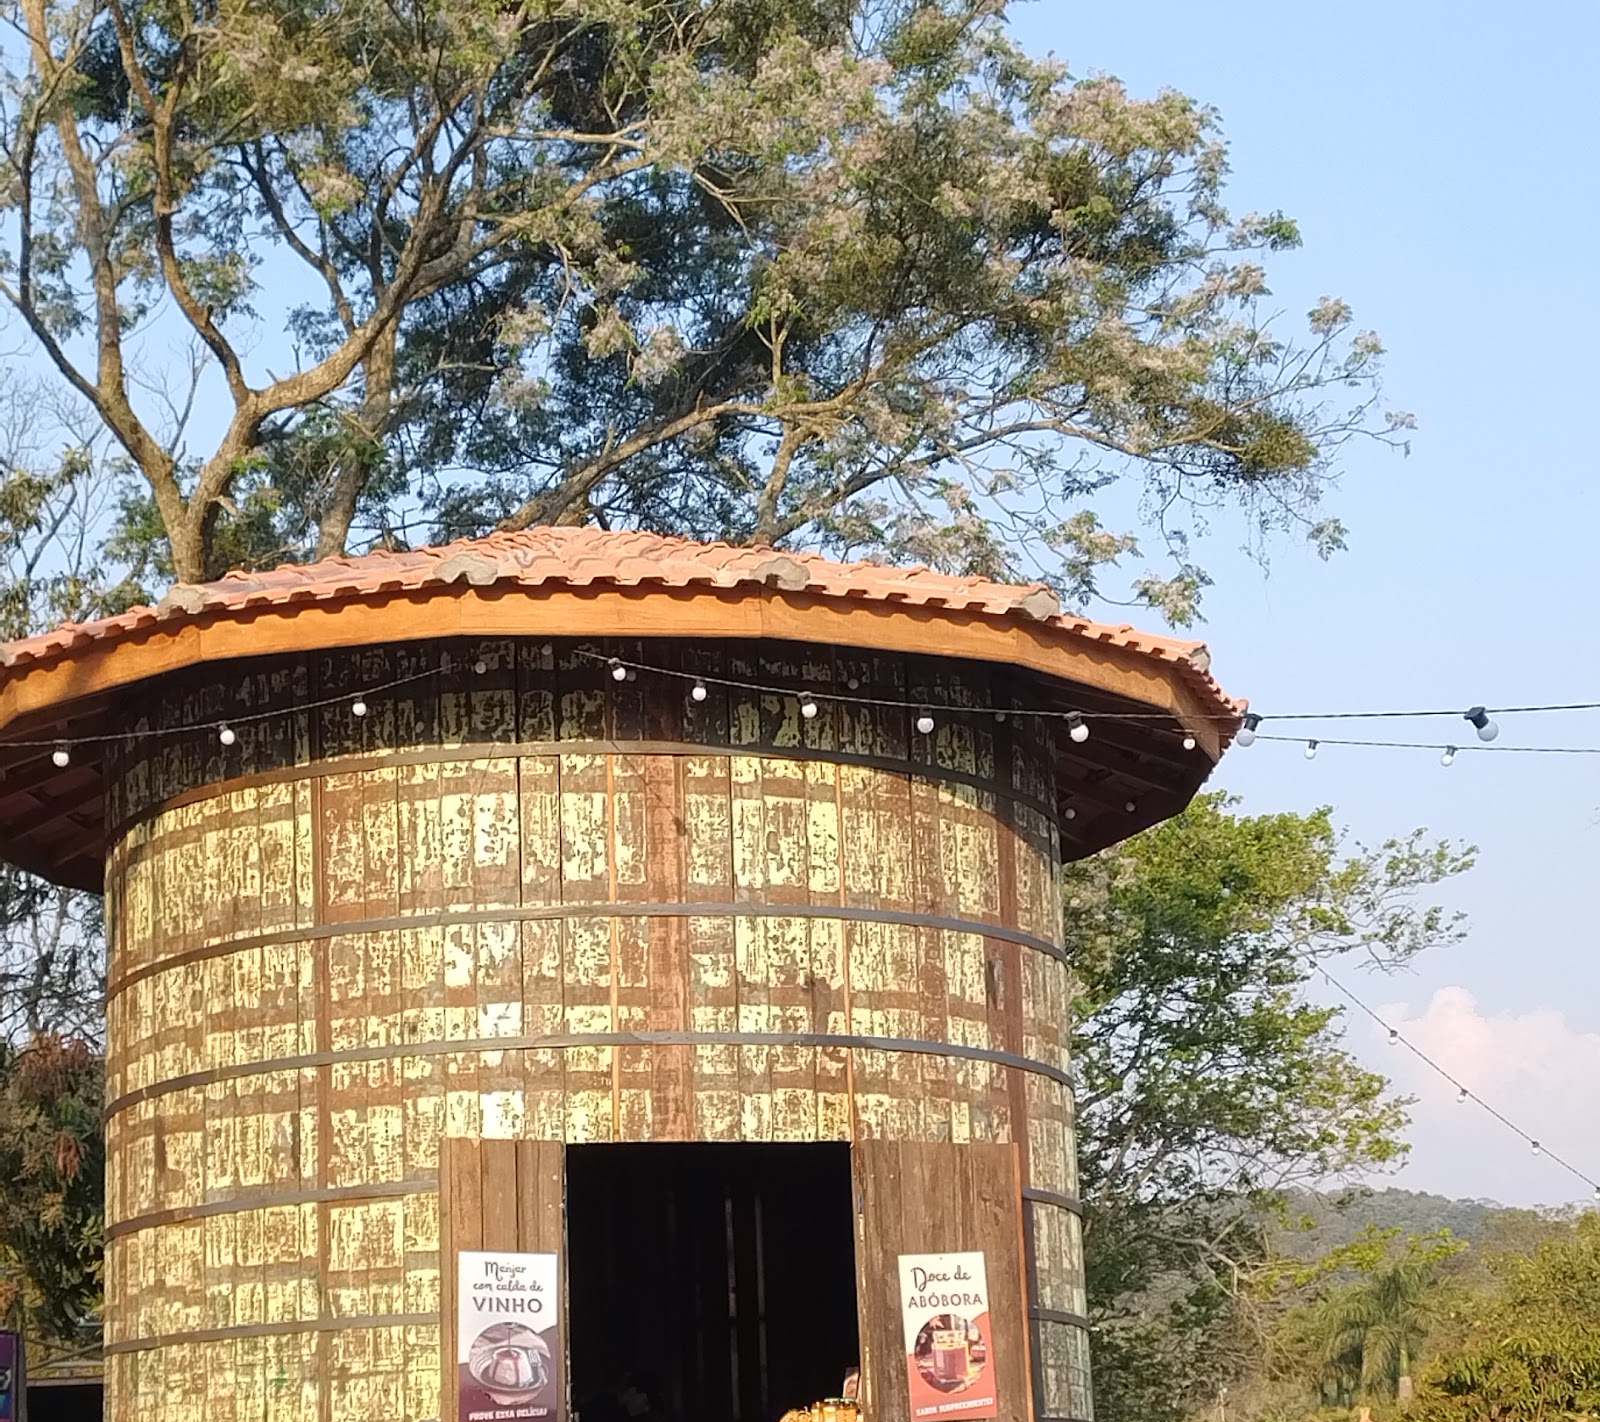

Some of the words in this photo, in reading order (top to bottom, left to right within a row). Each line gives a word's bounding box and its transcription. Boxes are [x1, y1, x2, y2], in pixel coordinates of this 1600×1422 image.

[484, 1261, 527, 1282] Manjar
[910, 1267, 950, 1292] Doce
[953, 1265, 972, 1280] de
[473, 1283, 494, 1292] com
[496, 1280, 527, 1292] calda
[529, 1280, 544, 1292] de
[472, 1296, 543, 1314] VINHO
[908, 1292, 983, 1309] ABÓBORA
